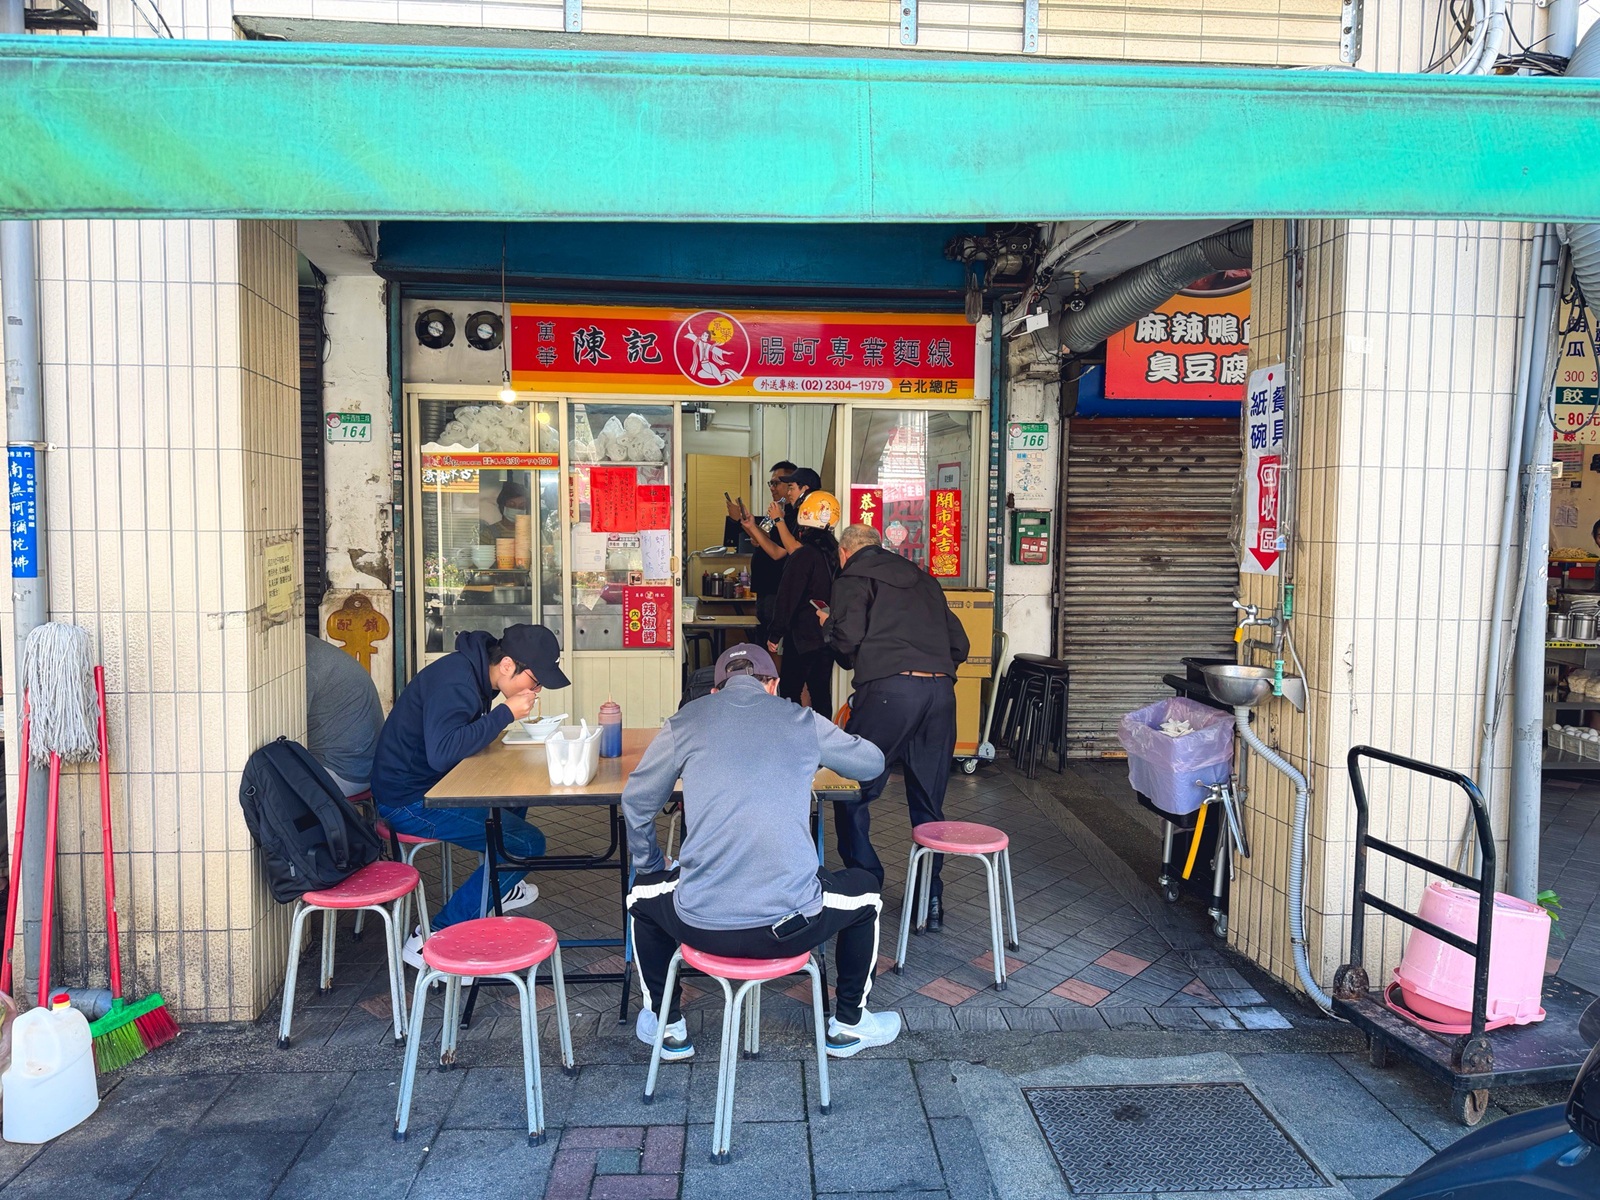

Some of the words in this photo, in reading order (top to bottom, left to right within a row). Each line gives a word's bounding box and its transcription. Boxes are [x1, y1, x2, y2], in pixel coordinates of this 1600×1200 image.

[1135, 312, 1250, 344] 麻辣鴨
[536, 321, 558, 368] 萬華
[571, 325, 663, 366] 陳記
[758, 336, 954, 367] 腸蚵專業麵線
[1146, 351, 1248, 384] 臭豆腐
[1564, 371, 1585, 382] 300
[801, 379, 823, 392] (02)
[825, 379, 885, 391] 2304-1979
[899, 379, 958, 394] 台北總店
[342, 425, 367, 438] 164
[1250, 389, 1268, 450] 紙碗
[1023, 434, 1044, 447] 166
[9, 461, 29, 573] 南無阿彌陀佛
[936, 492, 955, 552] 開市大吉
[1260, 463, 1277, 553] 回收區
[337, 616, 379, 632] 配鎖
[642, 602, 656, 643] 辣椒醬
